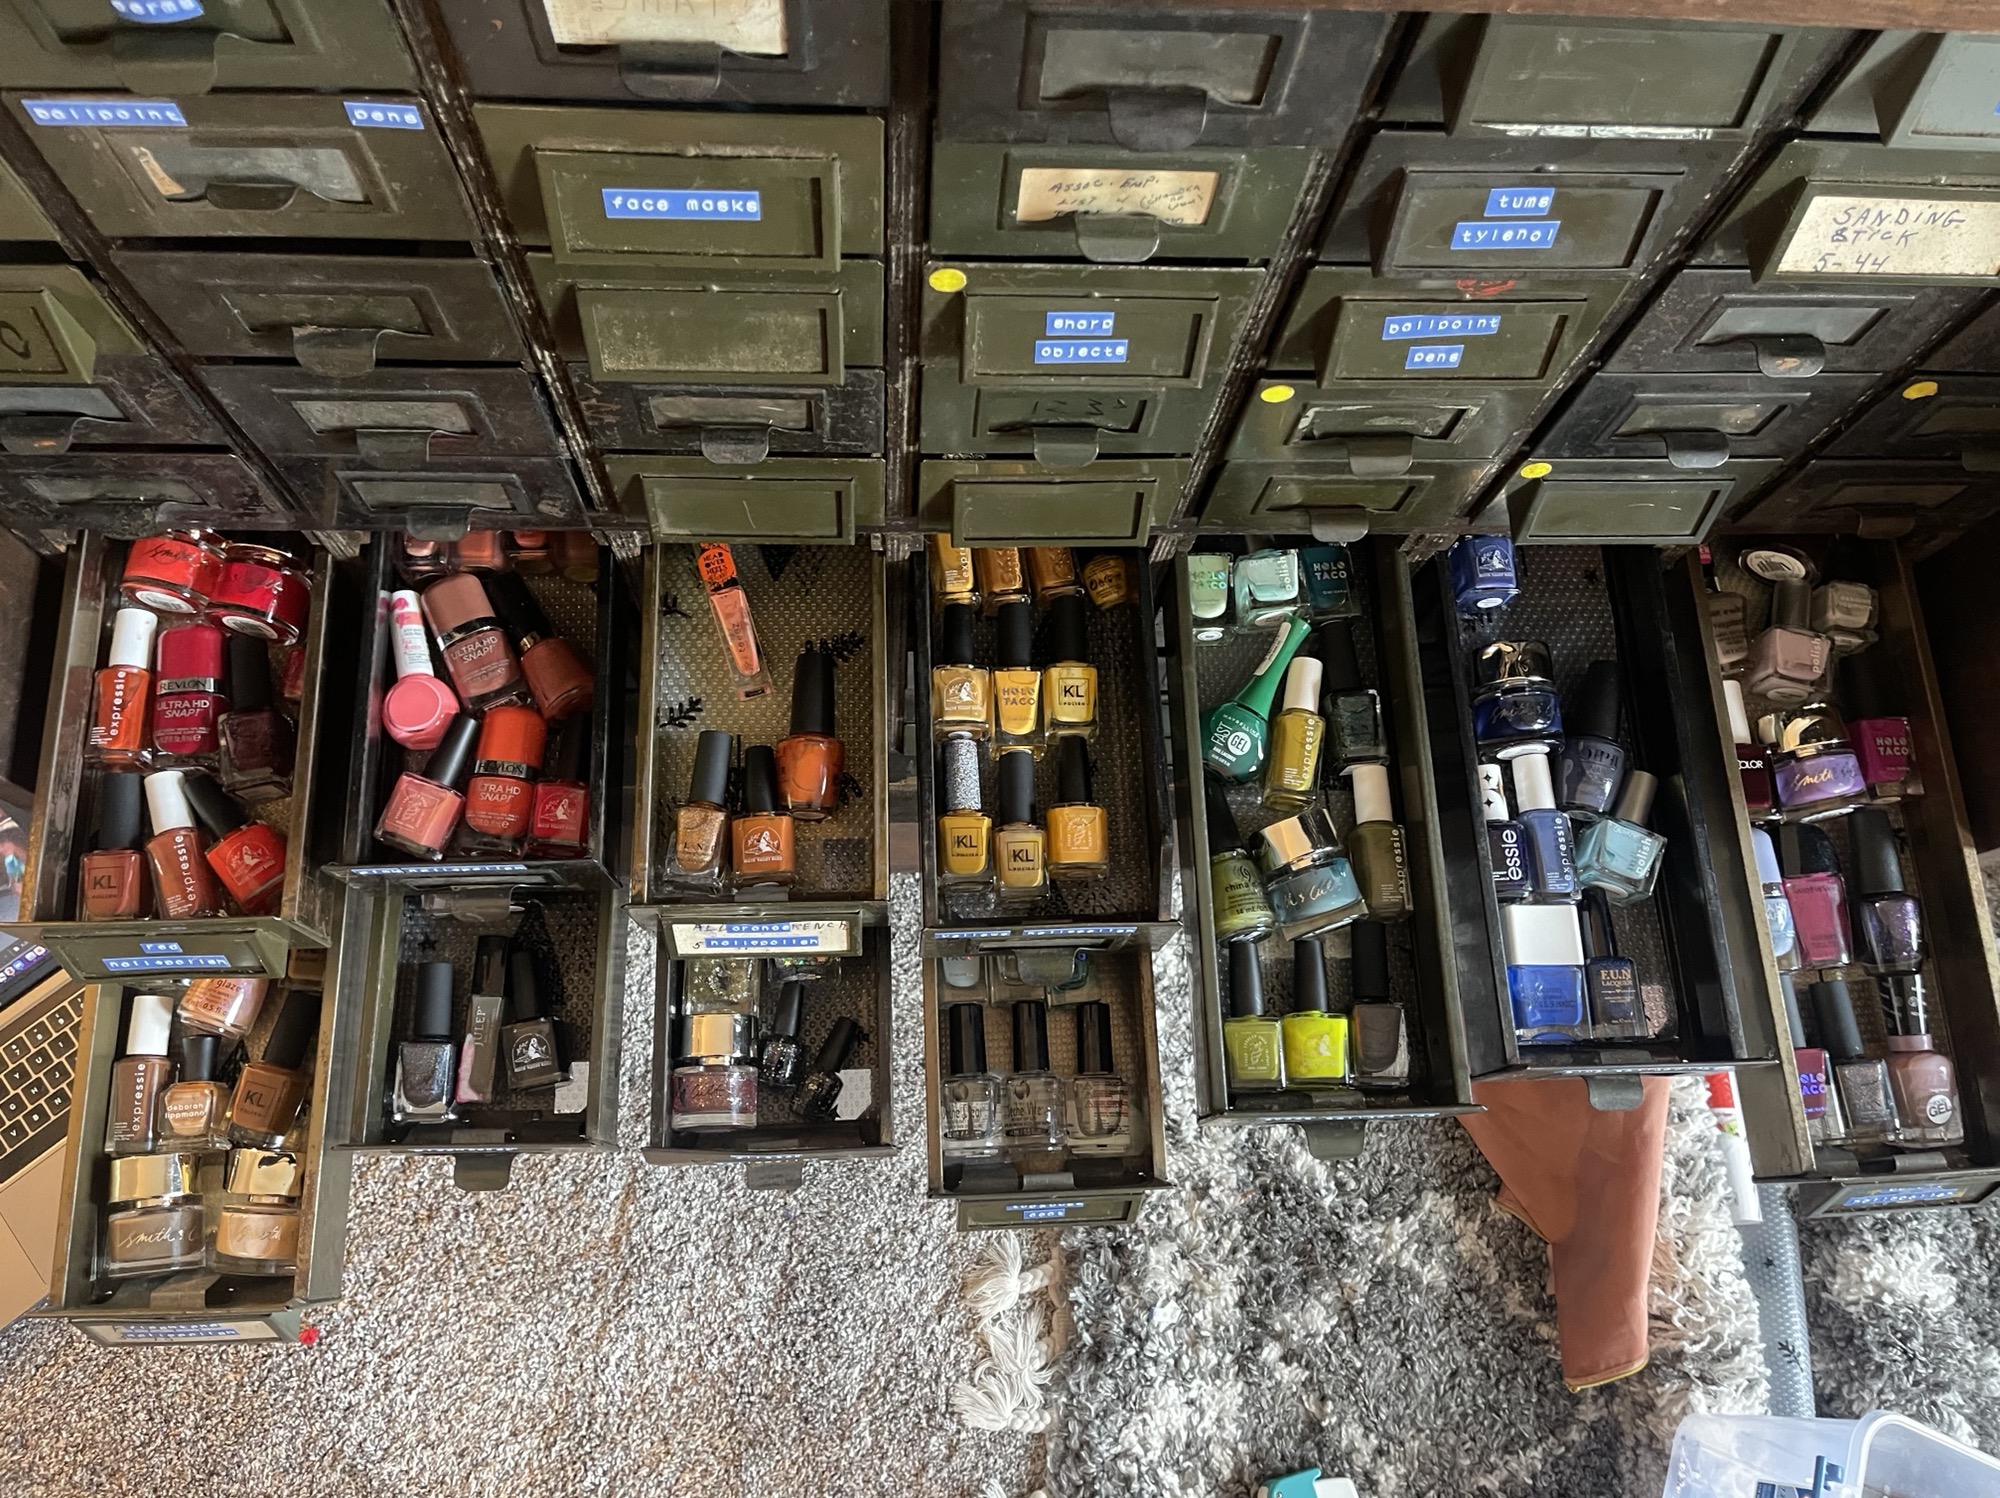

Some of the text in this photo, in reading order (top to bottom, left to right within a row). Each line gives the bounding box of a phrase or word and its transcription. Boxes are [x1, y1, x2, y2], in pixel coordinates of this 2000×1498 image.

[33, 107, 419, 125] ballpoint pens
[612, 196, 759, 213] face masks
[1498, 194, 1550, 209] tums
[1461, 228, 1554, 243] tylenol
[1053, 318, 1113, 330] sharp
[1388, 316, 1499, 335] ballpoint
[1040, 345, 1125, 359] objects
[1413, 351, 1460, 363] pens
[1280, 556, 1292, 591] polish
[1312, 562, 1346, 571] HOLO
[1314, 572, 1348, 581] TACO
[450, 636, 498, 660] ULTRA HD
[1812, 637, 1823, 675] polish
[161, 680, 206, 690] REVLON
[1002, 687, 1036, 697] HOLO
[1063, 684, 1085, 698] KL
[110, 671, 127, 736] expressie
[157, 699, 210, 710] ULTRA HD
[1003, 697, 1036, 707] TACO
[1211, 721, 1233, 746] FAST
[1875, 736, 1908, 746] HOLO
[1230, 734, 1248, 753] GEL
[1302, 718, 1316, 780] expressie
[1877, 747, 1910, 756] TACO
[505, 786, 521, 795] HD
[956, 834, 978, 848] KL
[1012, 849, 1035, 863] KL
[1502, 829, 1522, 881] essie
[1555, 817, 1572, 881] expressie
[1635, 838, 1652, 874] polish
[174, 835, 197, 901] expressie
[1390, 829, 1407, 894] expressie
[92, 875, 117, 890] KL
[145, 943, 179, 951] red
[474, 1007, 488, 1047] JULEP
[1799, 1072, 1826, 1083] OLO
[1800, 1083, 1827, 1095] ACO
[132, 1063, 146, 1132] expressie
[243, 1089, 266, 1108] KL
[166, 1103, 204, 1112] deborah
[1929, 1102, 1951, 1117] GEL
[164, 1111, 205, 1120] lippmann
